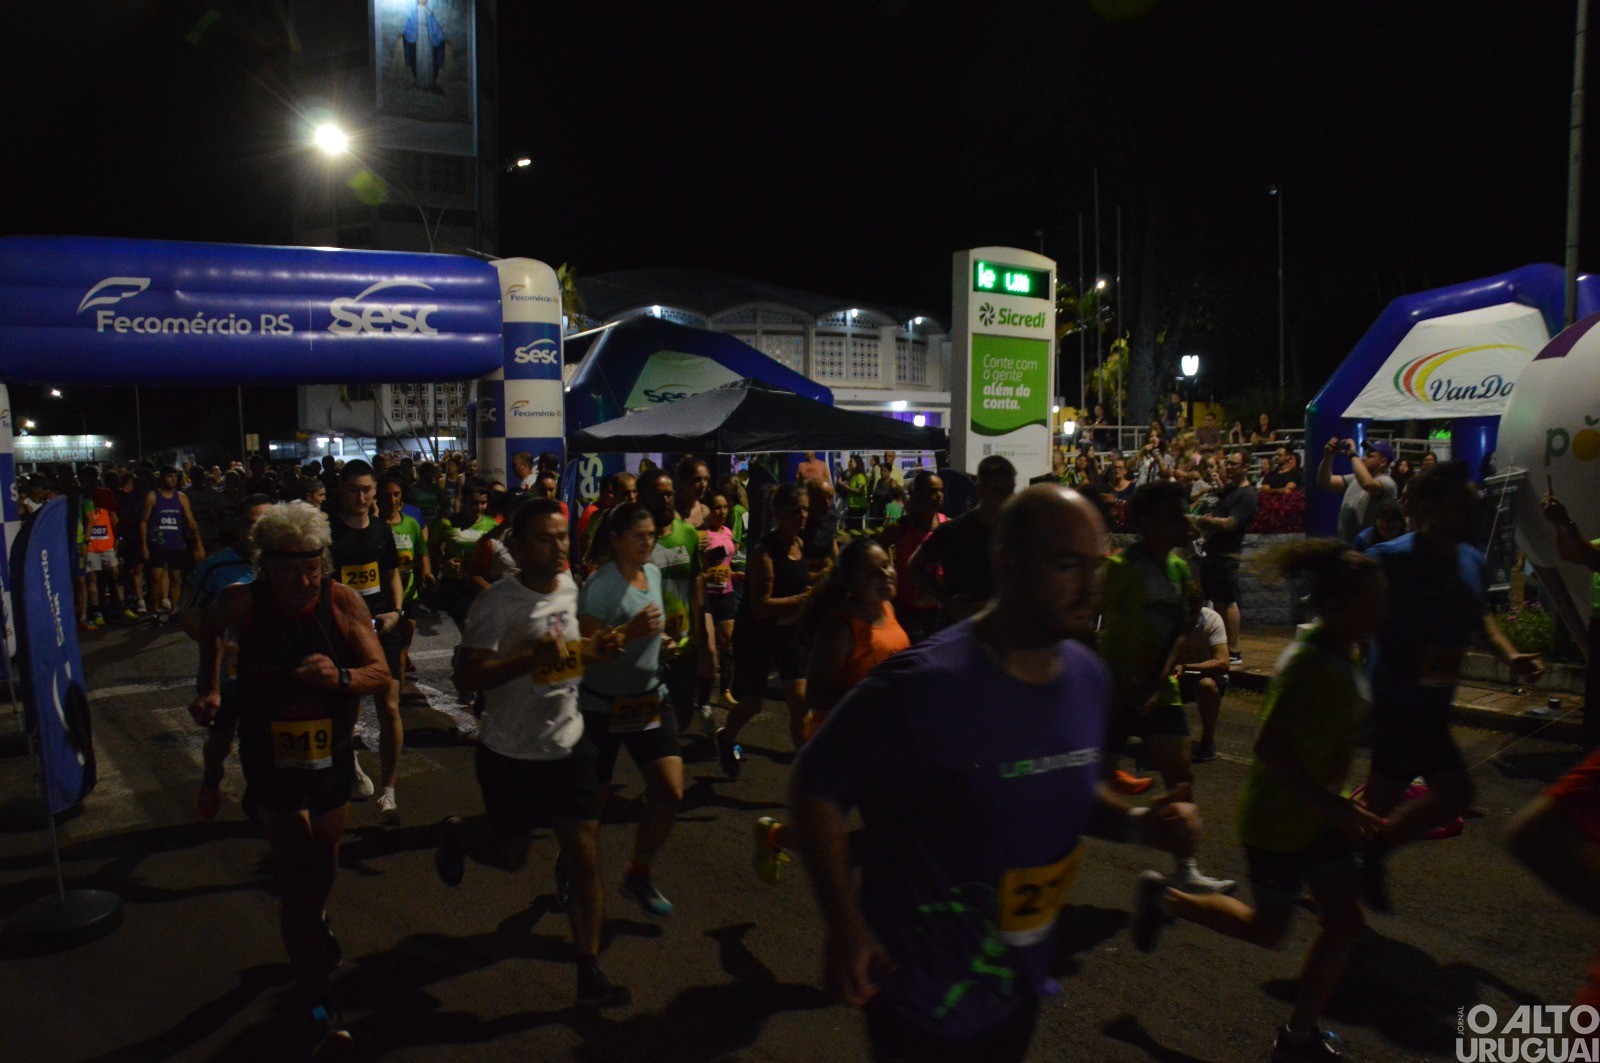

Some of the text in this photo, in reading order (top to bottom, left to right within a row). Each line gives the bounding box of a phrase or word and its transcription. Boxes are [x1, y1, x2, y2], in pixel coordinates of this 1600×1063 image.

[510, 294, 552, 303] Fecomércio
[96, 311, 294, 335] Fecomércio RS
[998, 307, 1046, 329] Sicredi
[983, 353, 1038, 370] Conte com
[992, 369, 1023, 382] gente
[983, 381, 1031, 397] além da
[983, 397, 1021, 409] conta.
[513, 408, 556, 417] Fecomércio
[23, 450, 54, 460] PADRE
[347, 569, 376, 584] 259
[279, 729, 328, 751] 319
